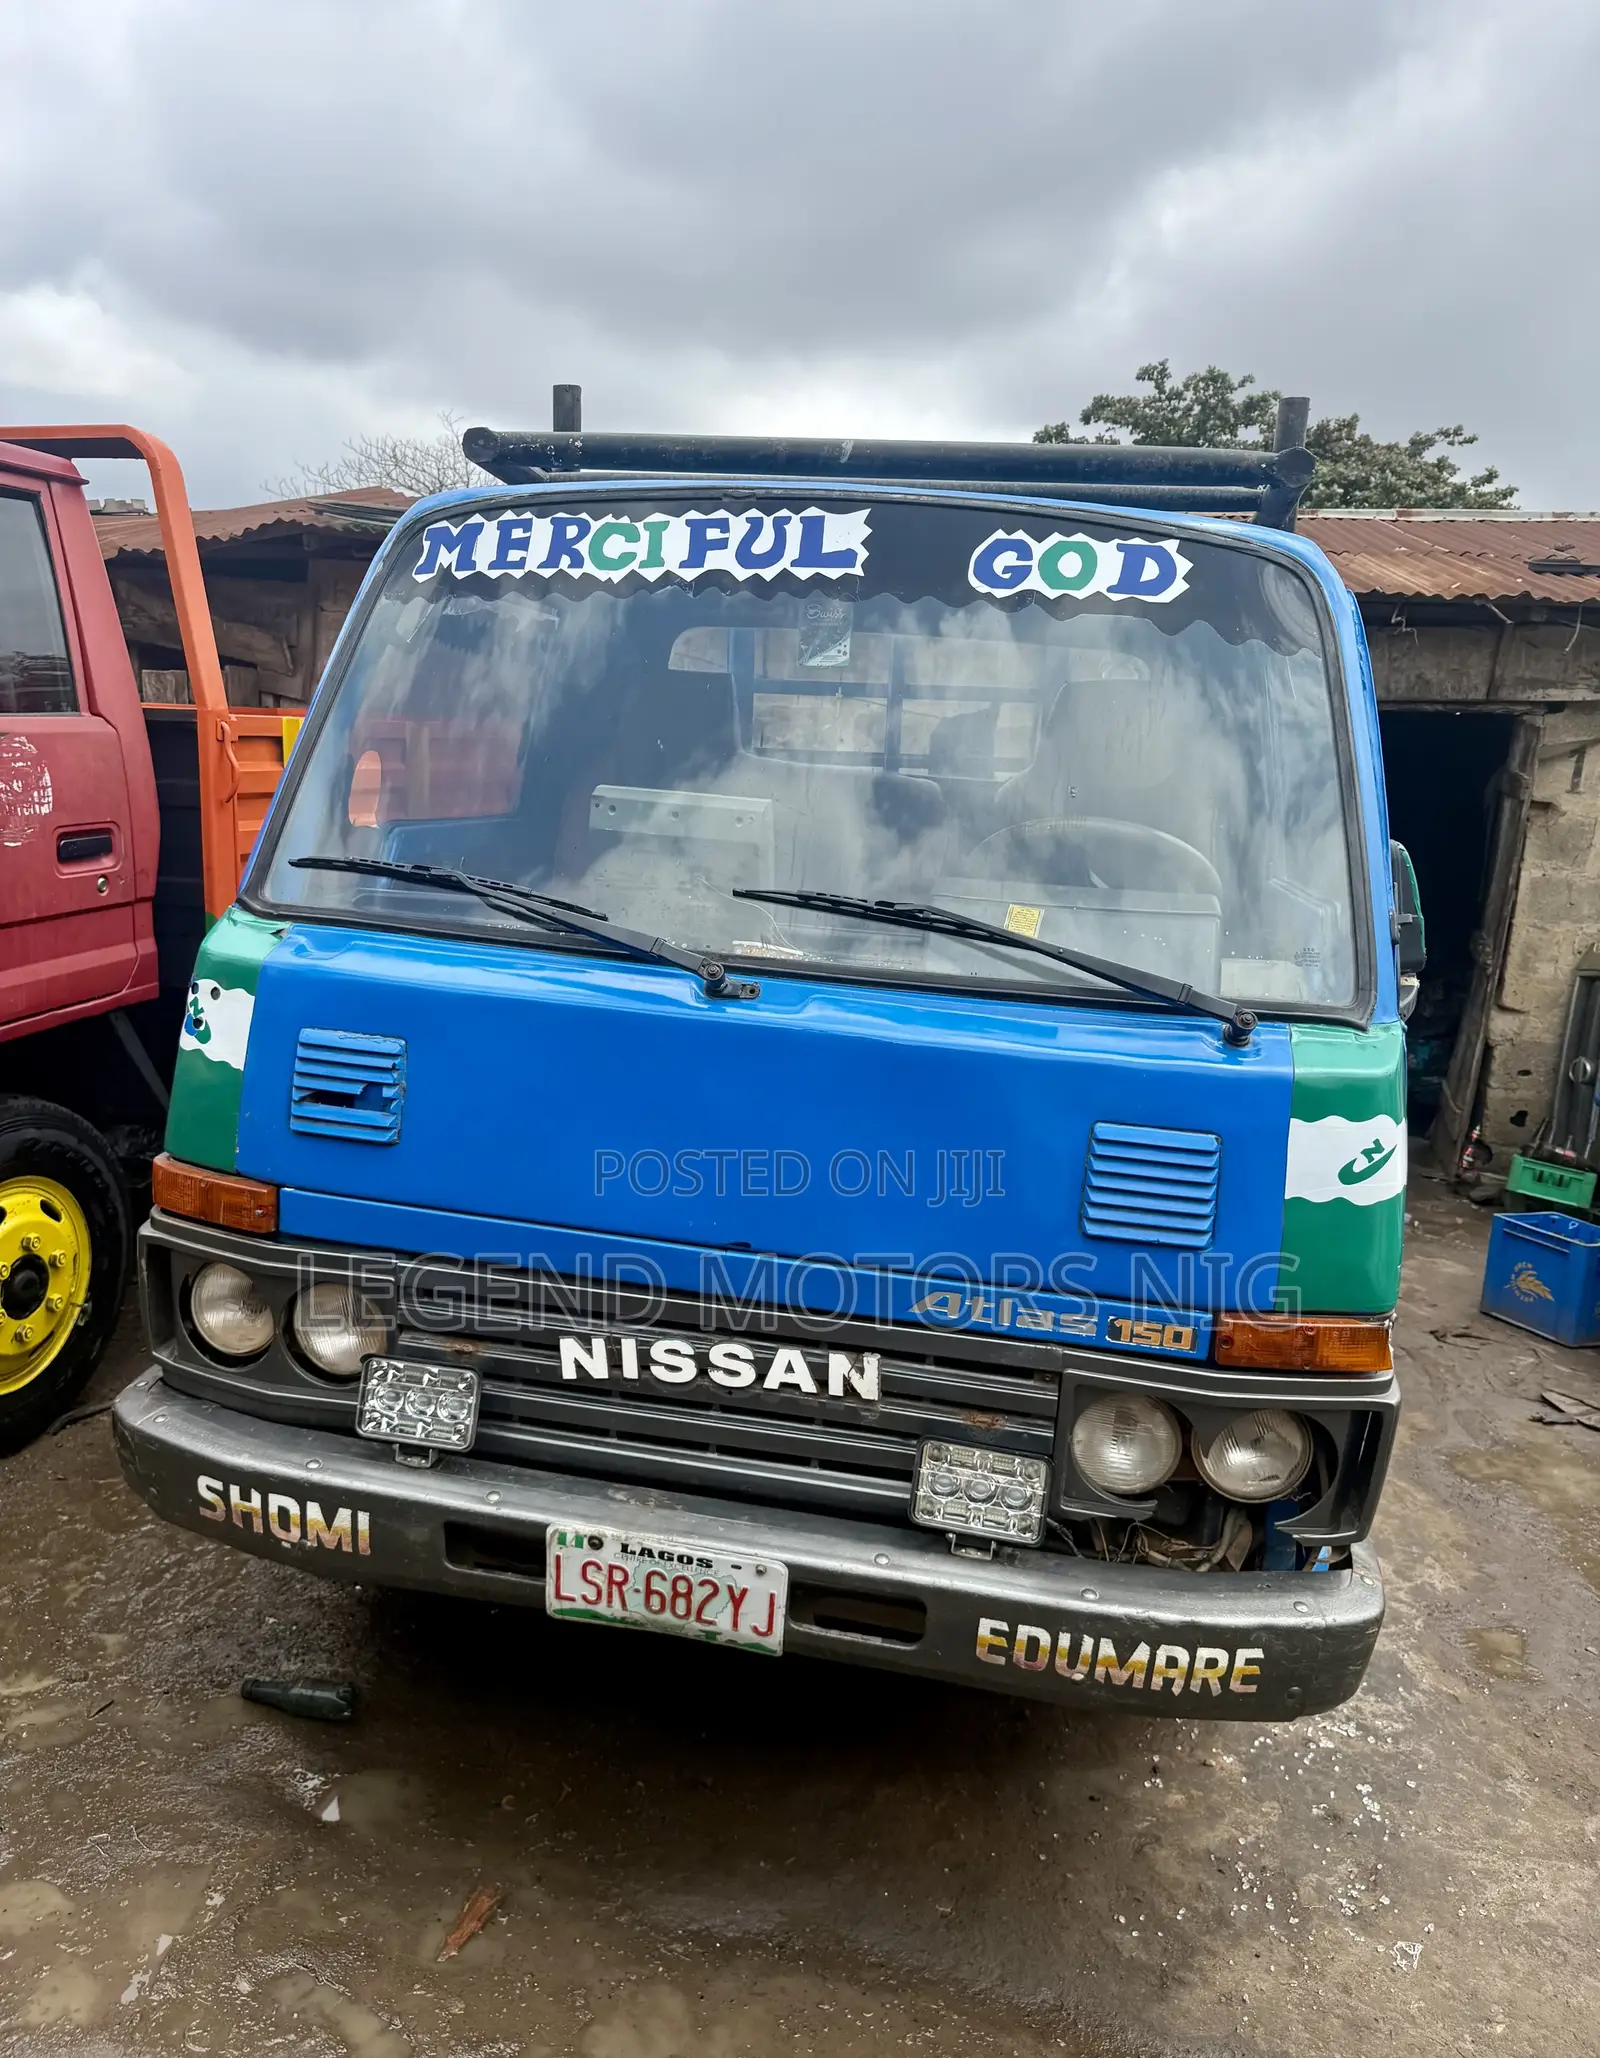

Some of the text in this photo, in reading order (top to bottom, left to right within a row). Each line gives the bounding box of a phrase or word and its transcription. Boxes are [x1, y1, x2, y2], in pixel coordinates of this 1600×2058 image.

[414, 514, 1178, 597] MERCIFUL GOD
[908, 1290, 1193, 1350] Atlas 150
[558, 1335, 883, 1401] NISSAN
[620, 1542, 714, 1569] LAGOS
[975, 1616, 1266, 1698] EDUMARE
